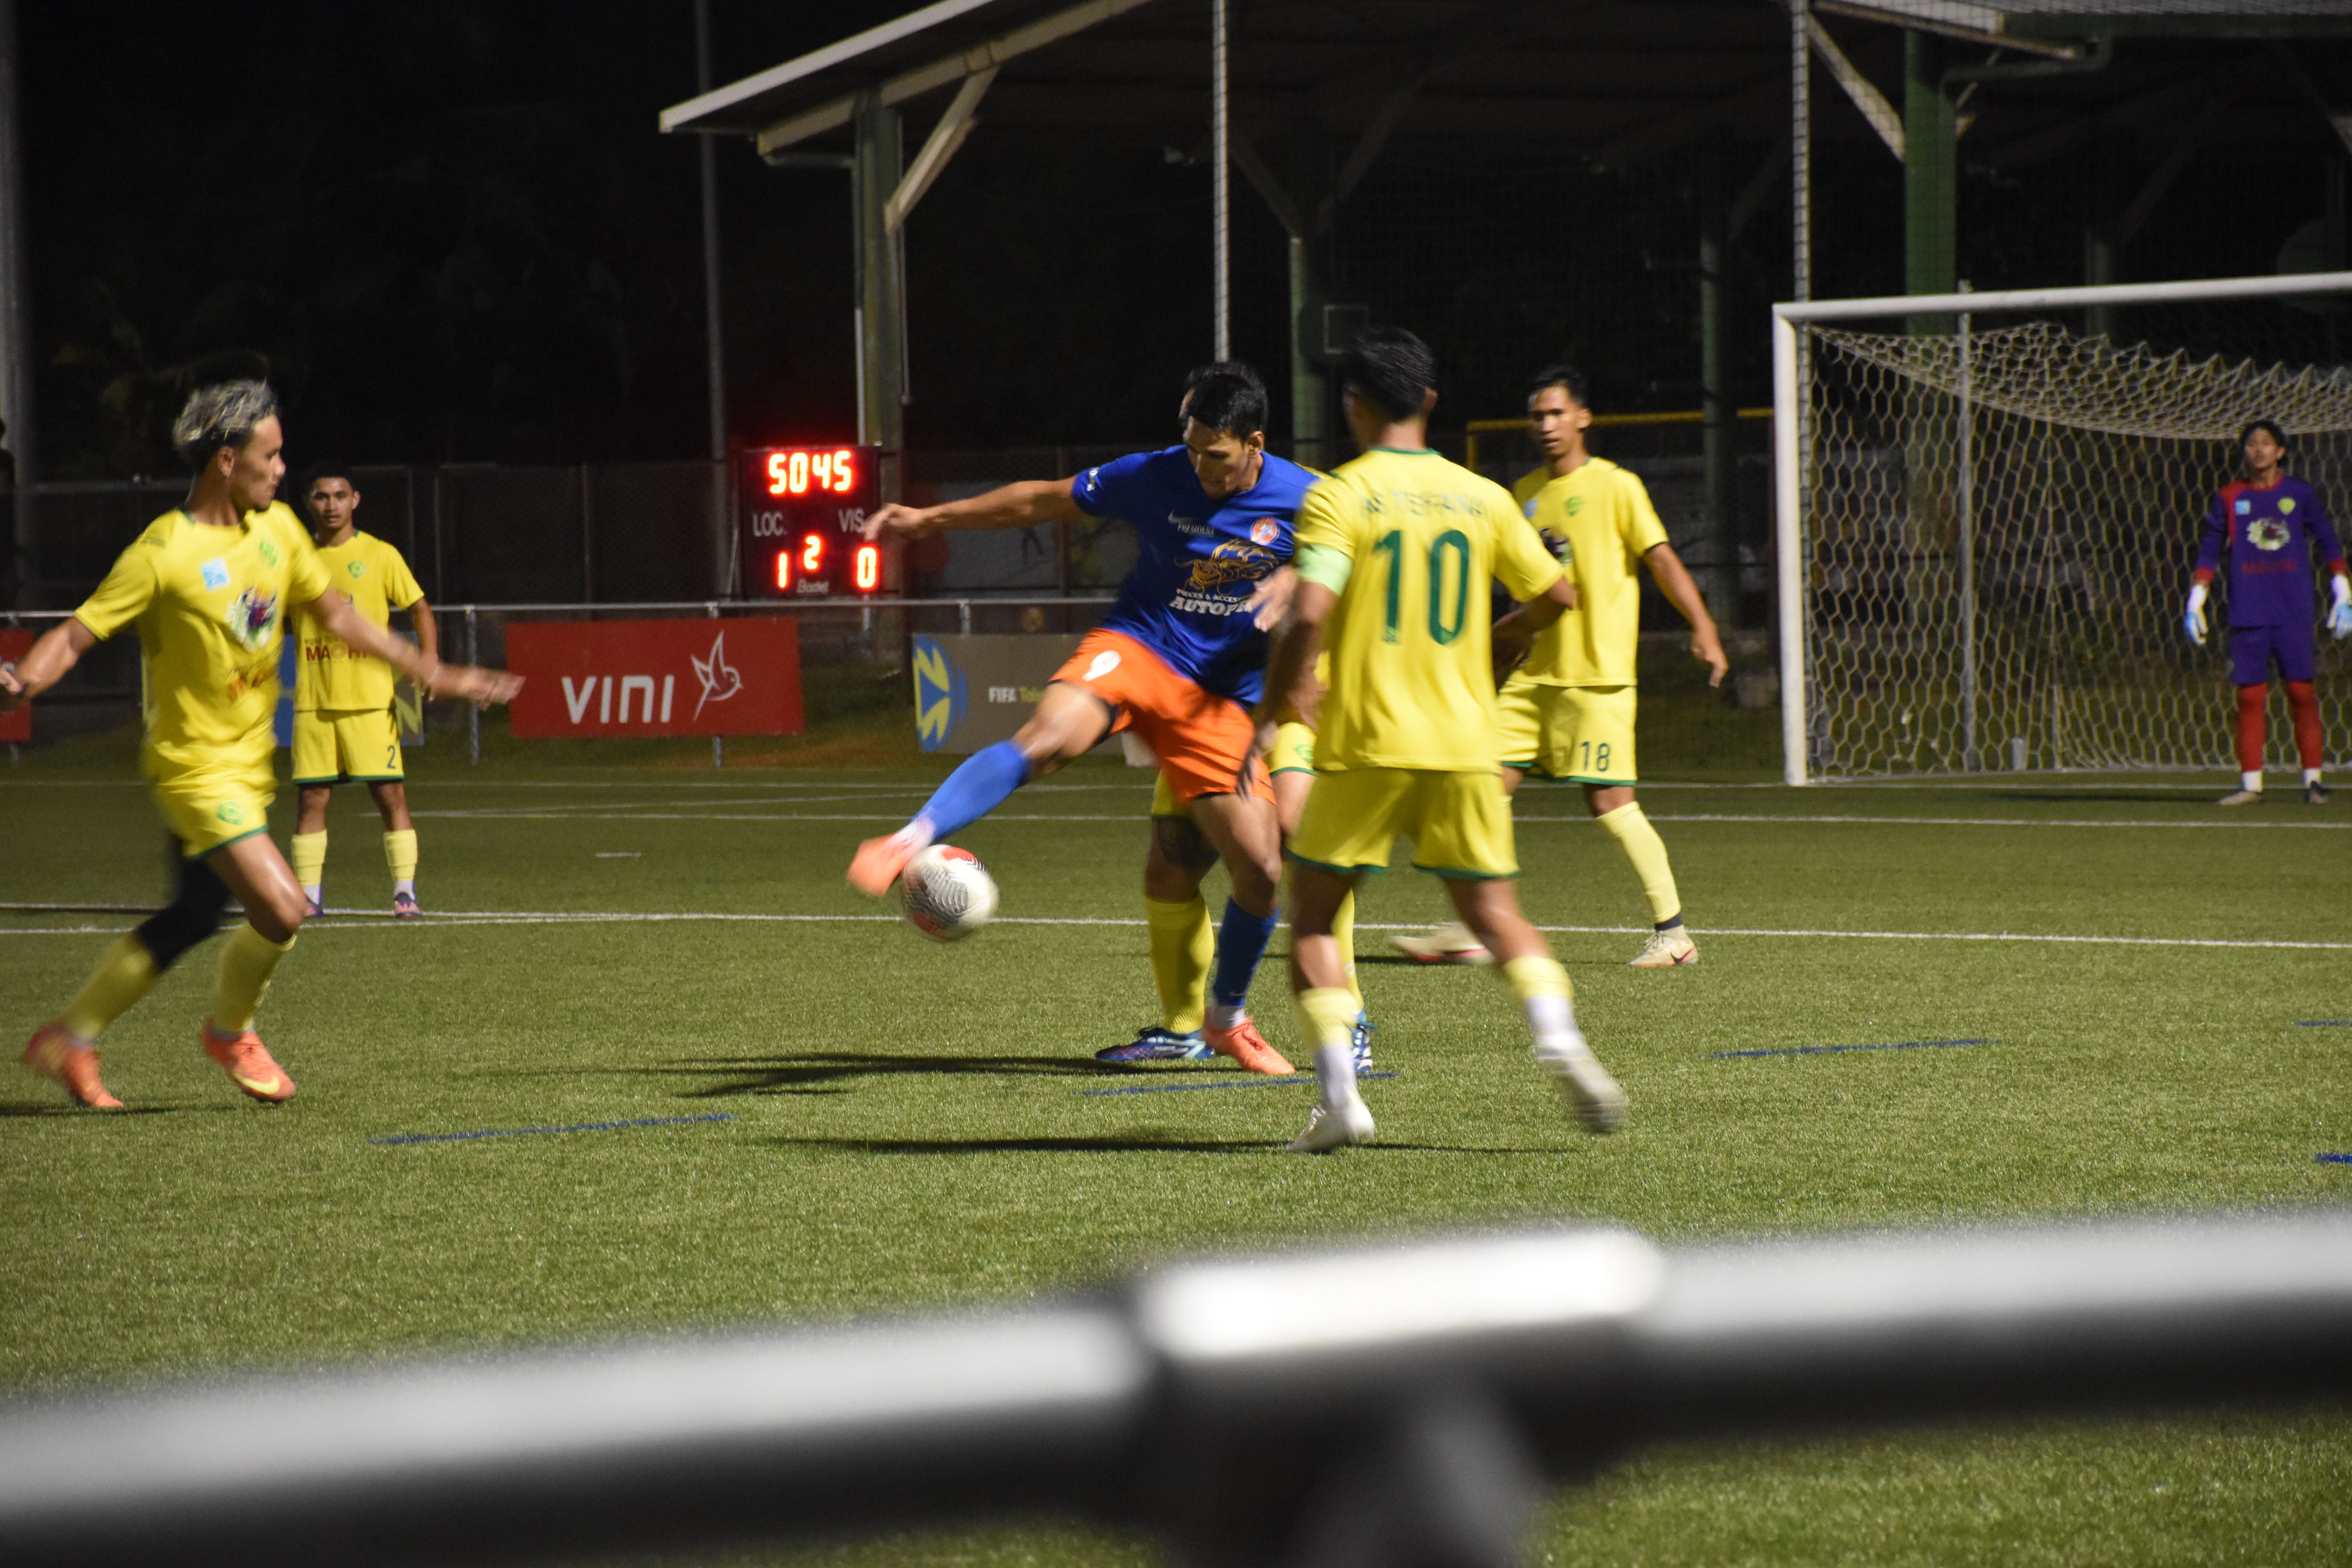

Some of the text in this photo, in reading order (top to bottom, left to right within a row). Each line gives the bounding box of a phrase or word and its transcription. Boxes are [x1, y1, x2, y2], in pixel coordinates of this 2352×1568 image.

[778, 535, 877, 588] 1 2 0
[1374, 529, 1470, 646] 10
[561, 675, 675, 724] VINI
[989, 687, 1017, 703] FIFA
[387, 745, 396, 769] 2
[1581, 741, 1611, 772] 18
